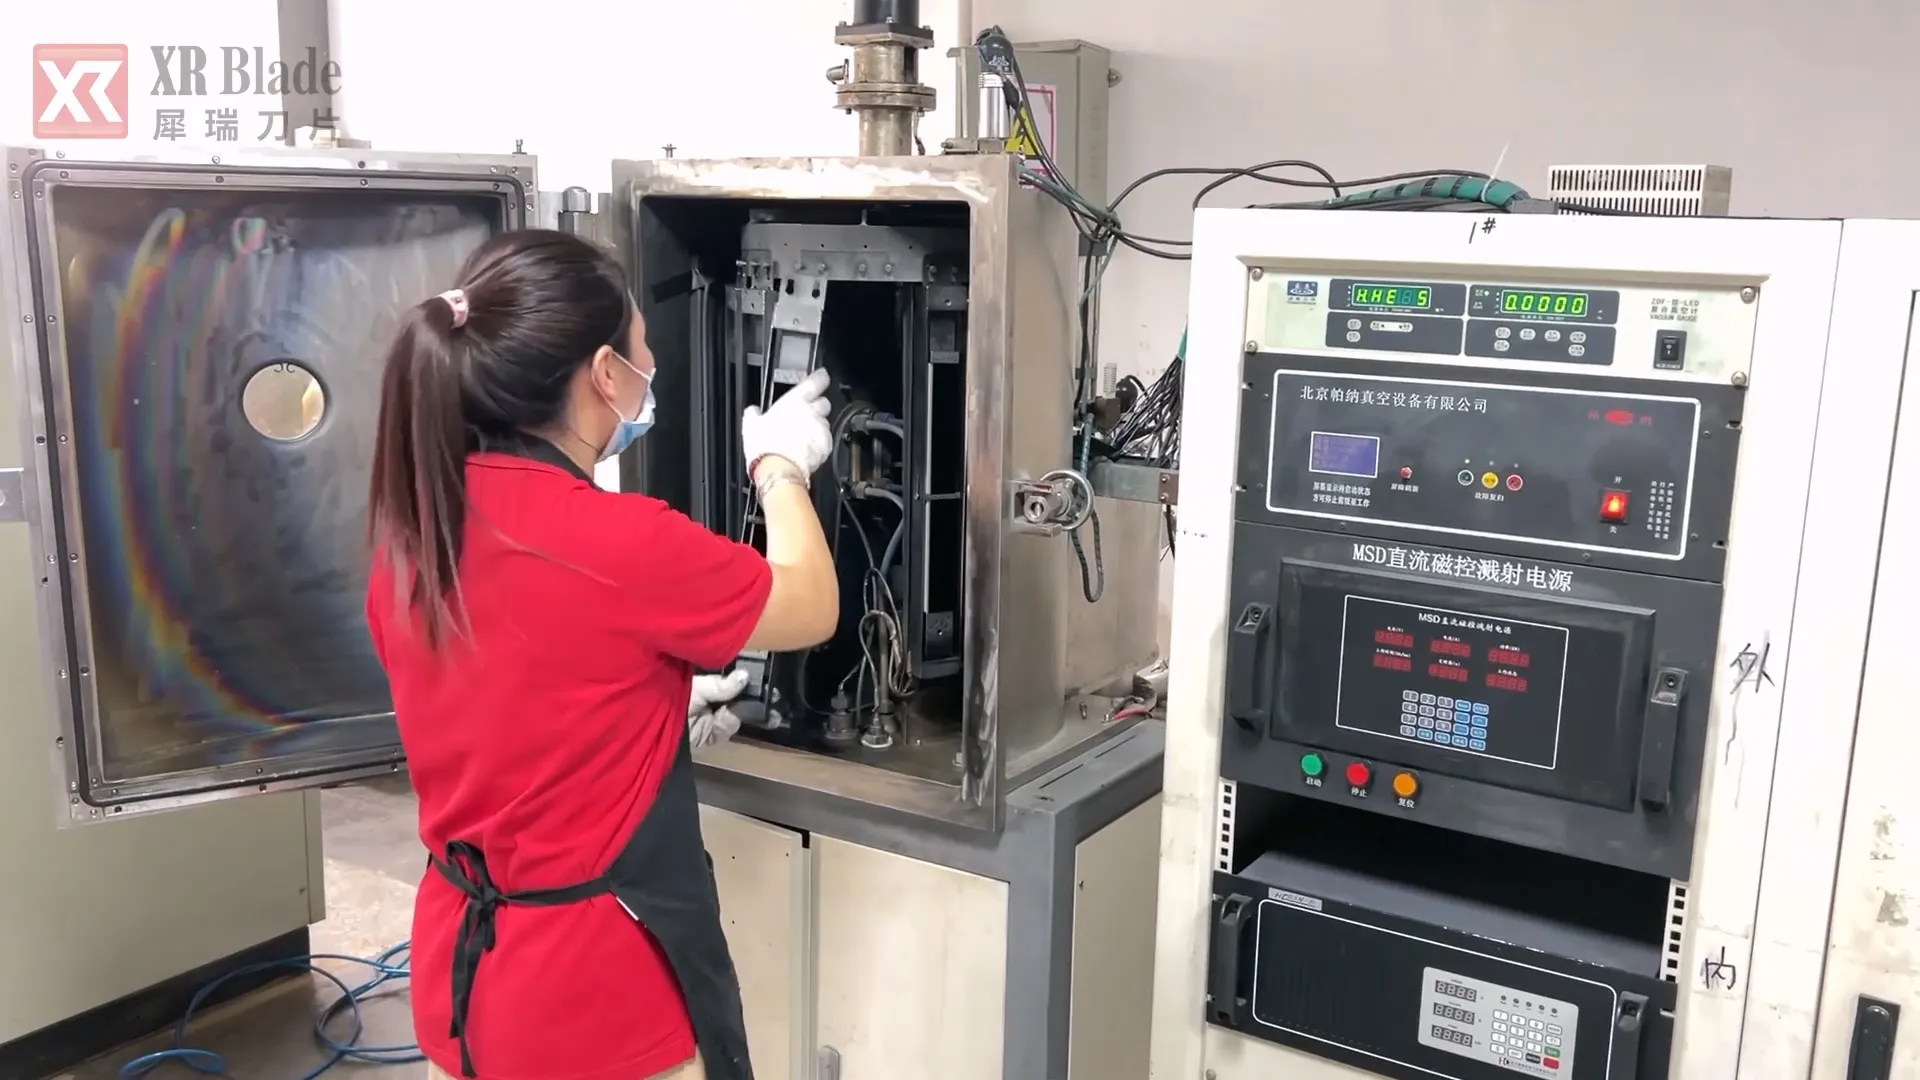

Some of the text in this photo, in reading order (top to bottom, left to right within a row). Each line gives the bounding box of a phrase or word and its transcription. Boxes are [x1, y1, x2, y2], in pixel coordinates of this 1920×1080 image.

[1300, 385, 1488, 414] 北京帕纳真空设备有限公司
[1353, 543, 1574, 592] MSD直流磁控溅射电源
[1729, 642, 1776, 696] 外
[1305, 776, 1322, 788] 启动
[1350, 786, 1368, 798] 停止
[1397, 797, 1416, 809] 复位
[1704, 946, 1737, 991] 内
